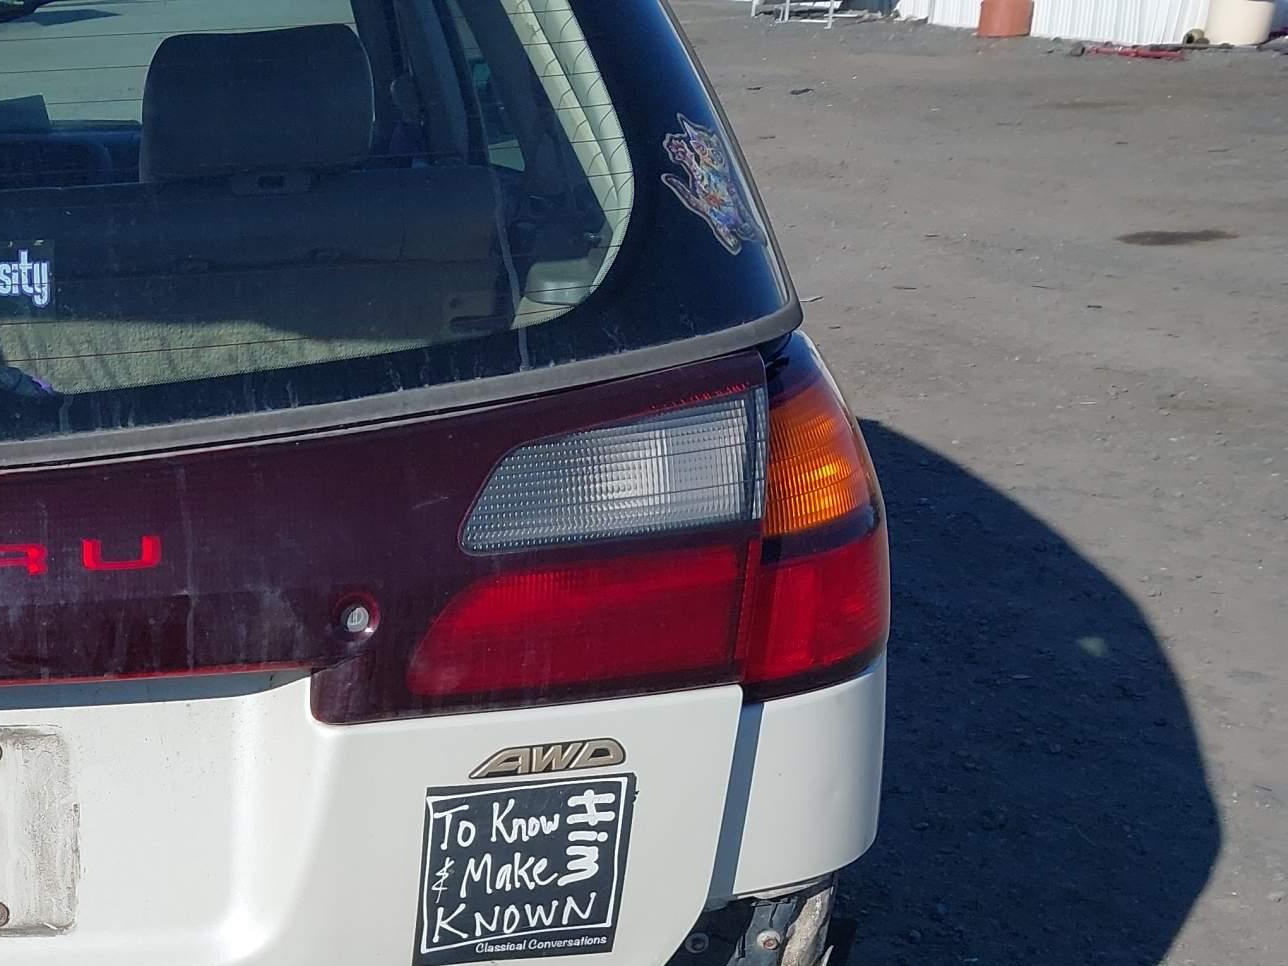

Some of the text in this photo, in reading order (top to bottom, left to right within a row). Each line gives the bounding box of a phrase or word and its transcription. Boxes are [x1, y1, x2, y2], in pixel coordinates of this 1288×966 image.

[468, 737, 627, 780] AWD
[433, 798, 561, 850] To Know
[557, 789, 616, 887] Him
[460, 852, 559, 899] Make
[432, 892, 598, 944] KNOWN
[475, 934, 608, 954] Classical Conversations
